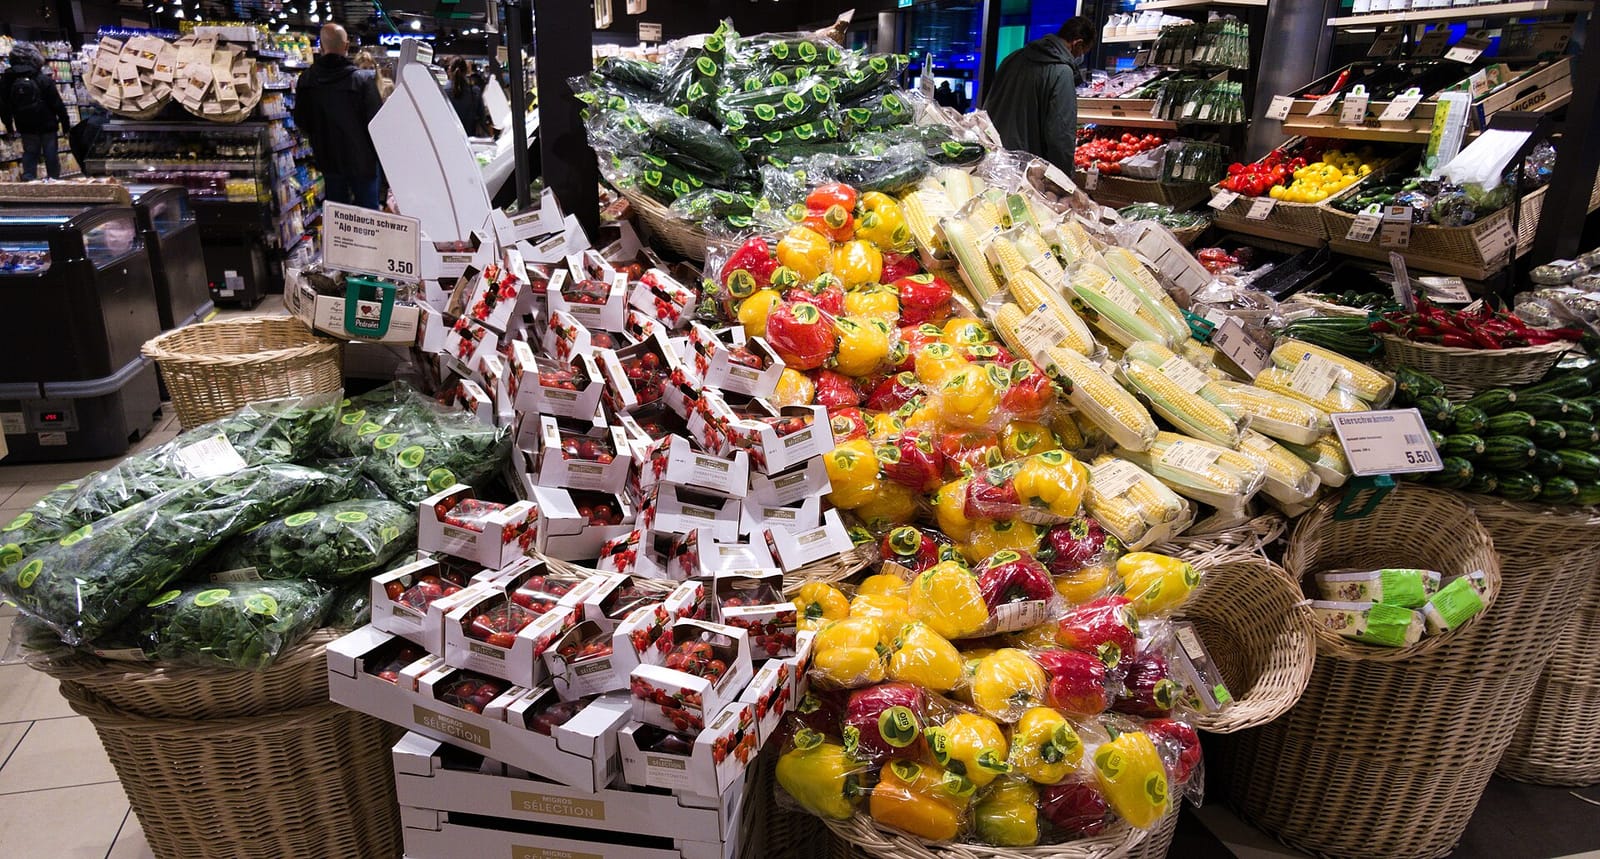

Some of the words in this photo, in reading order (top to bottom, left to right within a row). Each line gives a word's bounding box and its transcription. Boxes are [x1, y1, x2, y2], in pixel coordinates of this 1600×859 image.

[334, 210, 375, 226] Knoblauch
[376, 218, 408, 232] schwarz
[387, 259, 413, 275] 3.50
[1339, 415, 1394, 426] Eierschwämme
[1405, 450, 1433, 464] 5.50
[438, 715, 463, 728] MIGROS
[899, 712, 909, 726] BIO
[423, 715, 482, 744] SÉLECTION
[542, 796, 572, 805] MIGROS
[523, 799, 594, 818] SÉLECTION
[542, 849, 572, 859] MIGROS
